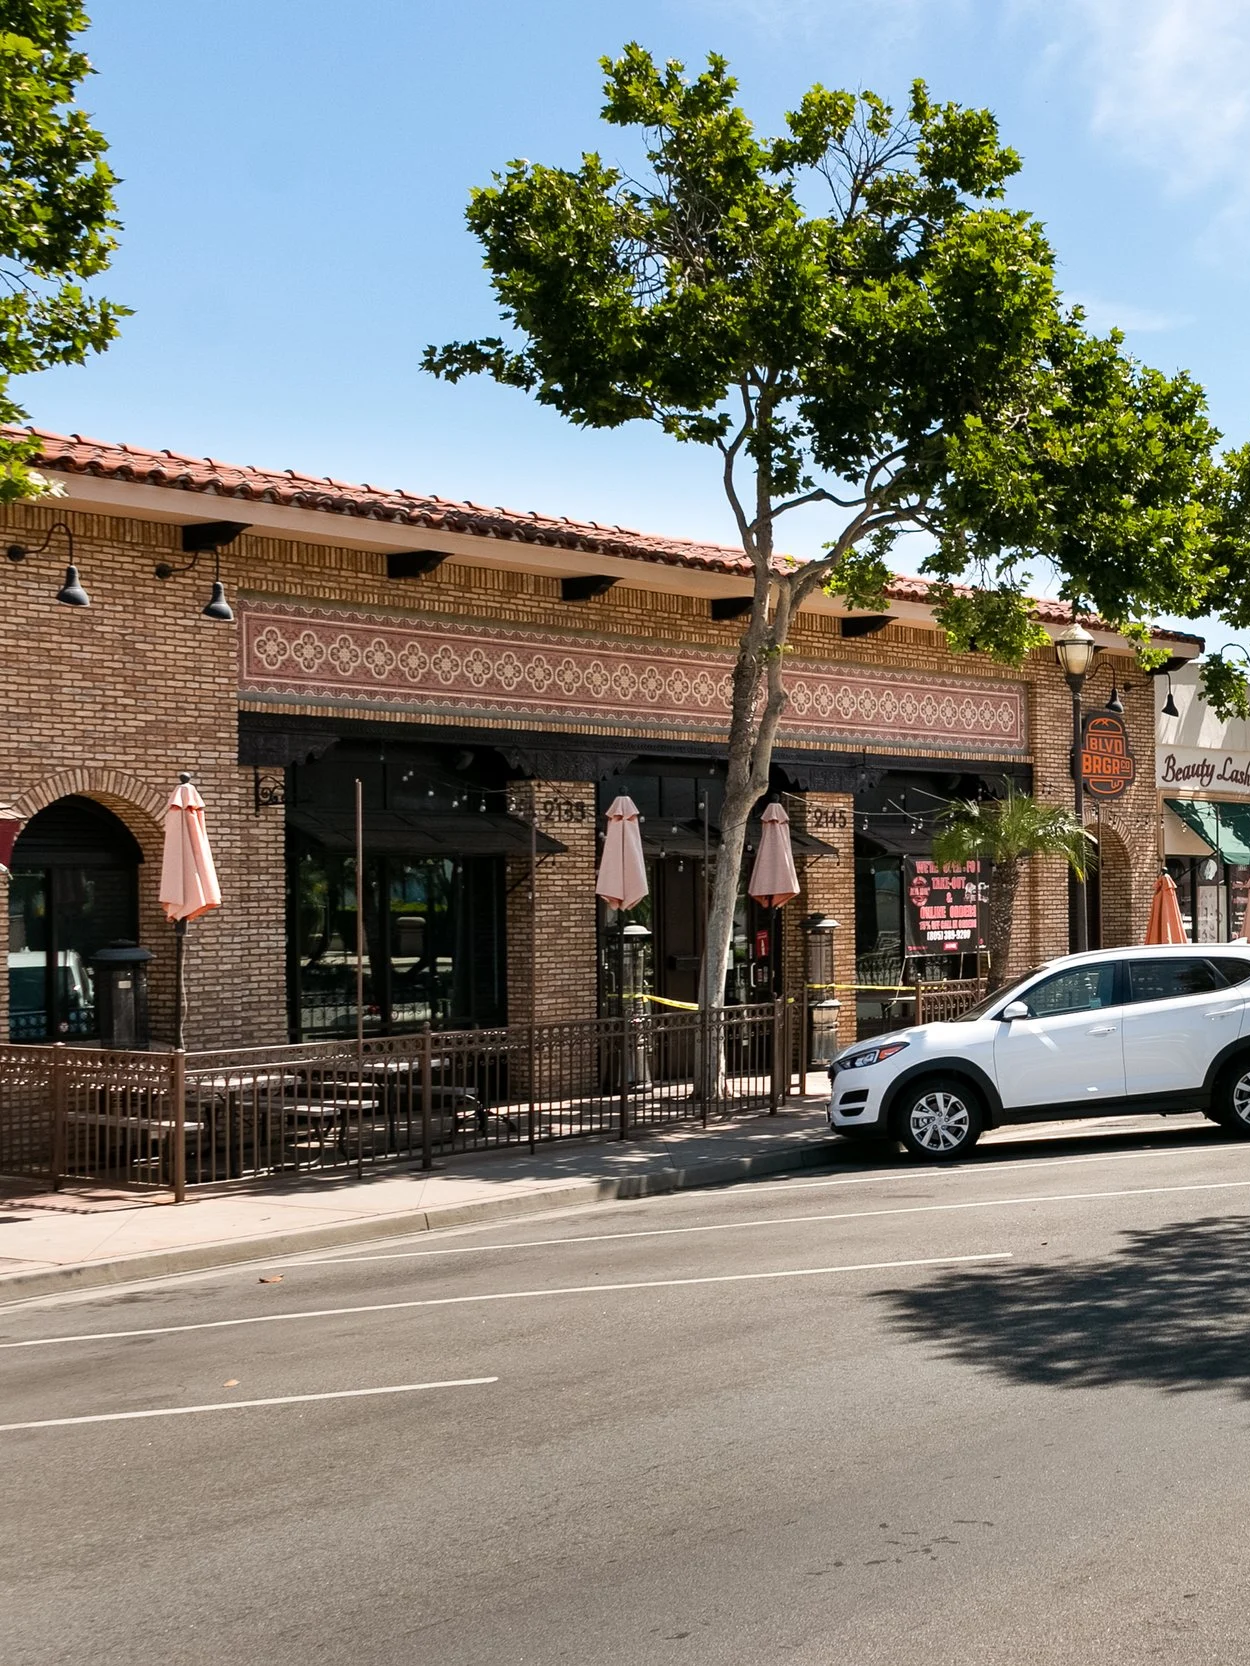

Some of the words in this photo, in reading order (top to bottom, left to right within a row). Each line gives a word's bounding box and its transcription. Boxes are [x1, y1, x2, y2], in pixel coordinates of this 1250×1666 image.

[1089, 737, 1123, 755] BLVD
[1082, 753, 1120, 774] BRGR
[1161, 753, 1216, 788] Beauty
[814, 808, 847, 829] 2145
